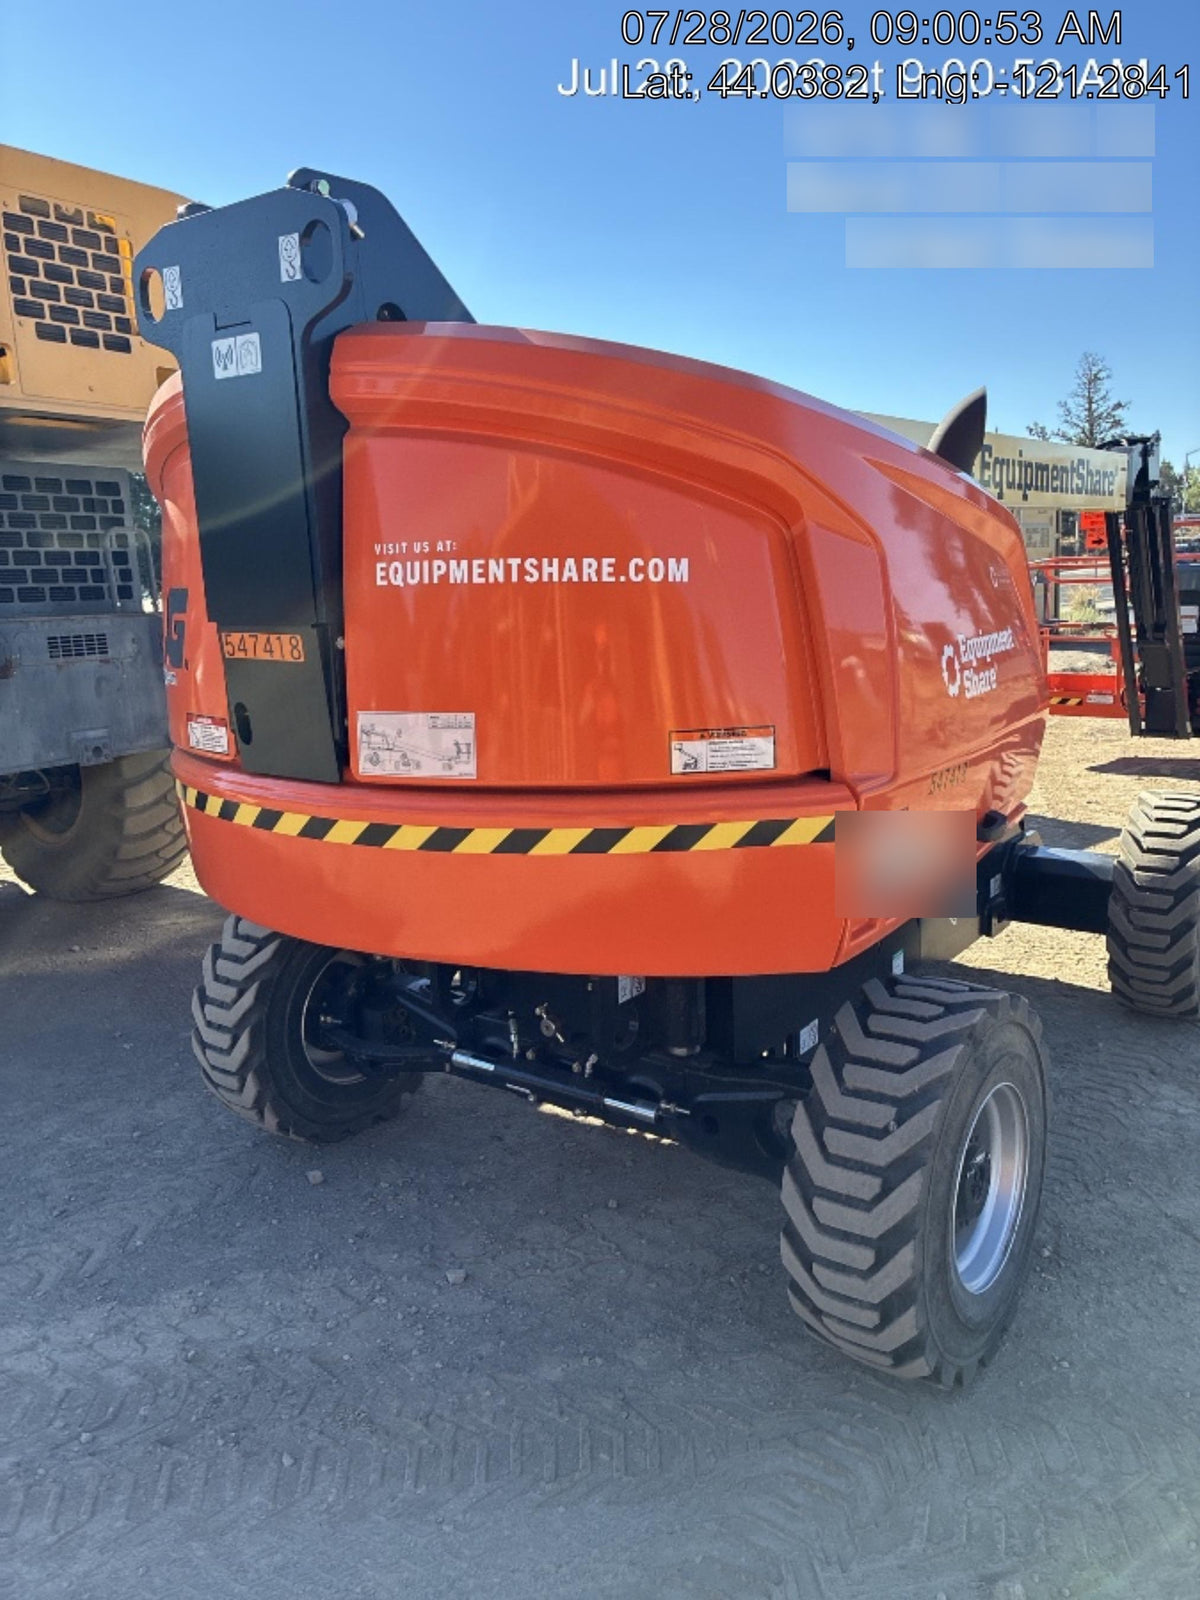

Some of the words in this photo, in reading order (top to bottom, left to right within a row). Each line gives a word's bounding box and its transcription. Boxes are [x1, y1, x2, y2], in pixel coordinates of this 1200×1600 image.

[979, 443, 1115, 501] EquipmentShare
[374, 542, 407, 556] VISIT
[413, 541, 430, 554] US
[436, 540, 457, 553] AT:
[375, 557, 689, 587] EQUIPMENTSHARE.COM
[224, 633, 302, 660] 547418
[956, 626, 1015, 667] Equipment
[963, 667, 997, 699] Share
